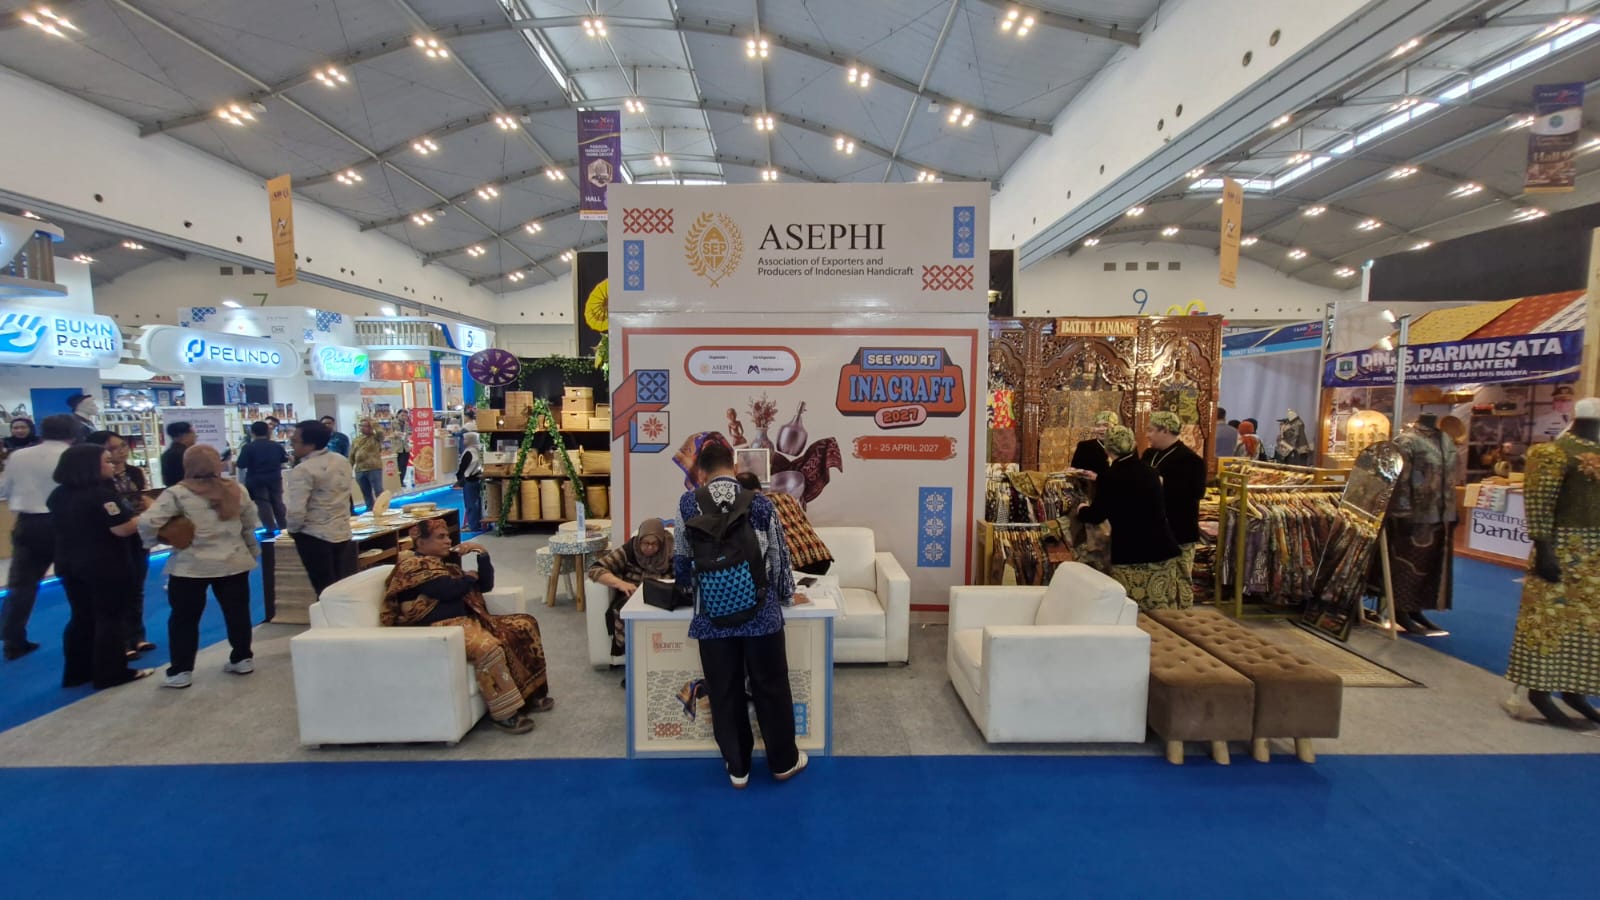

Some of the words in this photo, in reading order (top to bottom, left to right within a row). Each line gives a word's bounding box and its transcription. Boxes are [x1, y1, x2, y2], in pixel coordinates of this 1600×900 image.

[758, 223, 886, 250] ASEPHI
[757, 256, 809, 265] Association
[810, 256, 821, 265] of
[821, 257, 864, 267] Exporters
[865, 257, 884, 265] and
[758, 267, 802, 276] Producers
[803, 267, 814, 276] of
[815, 267, 864, 276] Indonesian
[866, 267, 914, 276] Handicraft
[252, 293, 268, 306] 7
[1132, 288, 1148, 314] 9
[55, 319, 113, 336] BUMN
[1061, 320, 1092, 334] BATIK
[1095, 320, 1134, 334] LANANG
[56, 335, 114, 351] Peduli
[1418, 338, 1563, 363] PARIWISATA
[210, 346, 281, 365] PELINDO
[867, 354, 892, 365] SEE
[895, 354, 917, 365] YOU
[920, 355, 936, 366] AT
[1385, 362, 1449, 374] POVINSI
[1453, 358, 1518, 371] BANTEN
[849, 375, 956, 403] INACRAFT
[882, 407, 919, 424] 2027
[862, 444, 872, 452] 21
[880, 444, 891, 452] 25
[891, 444, 917, 452] APRIL
[919, 444, 939, 452] 2027
